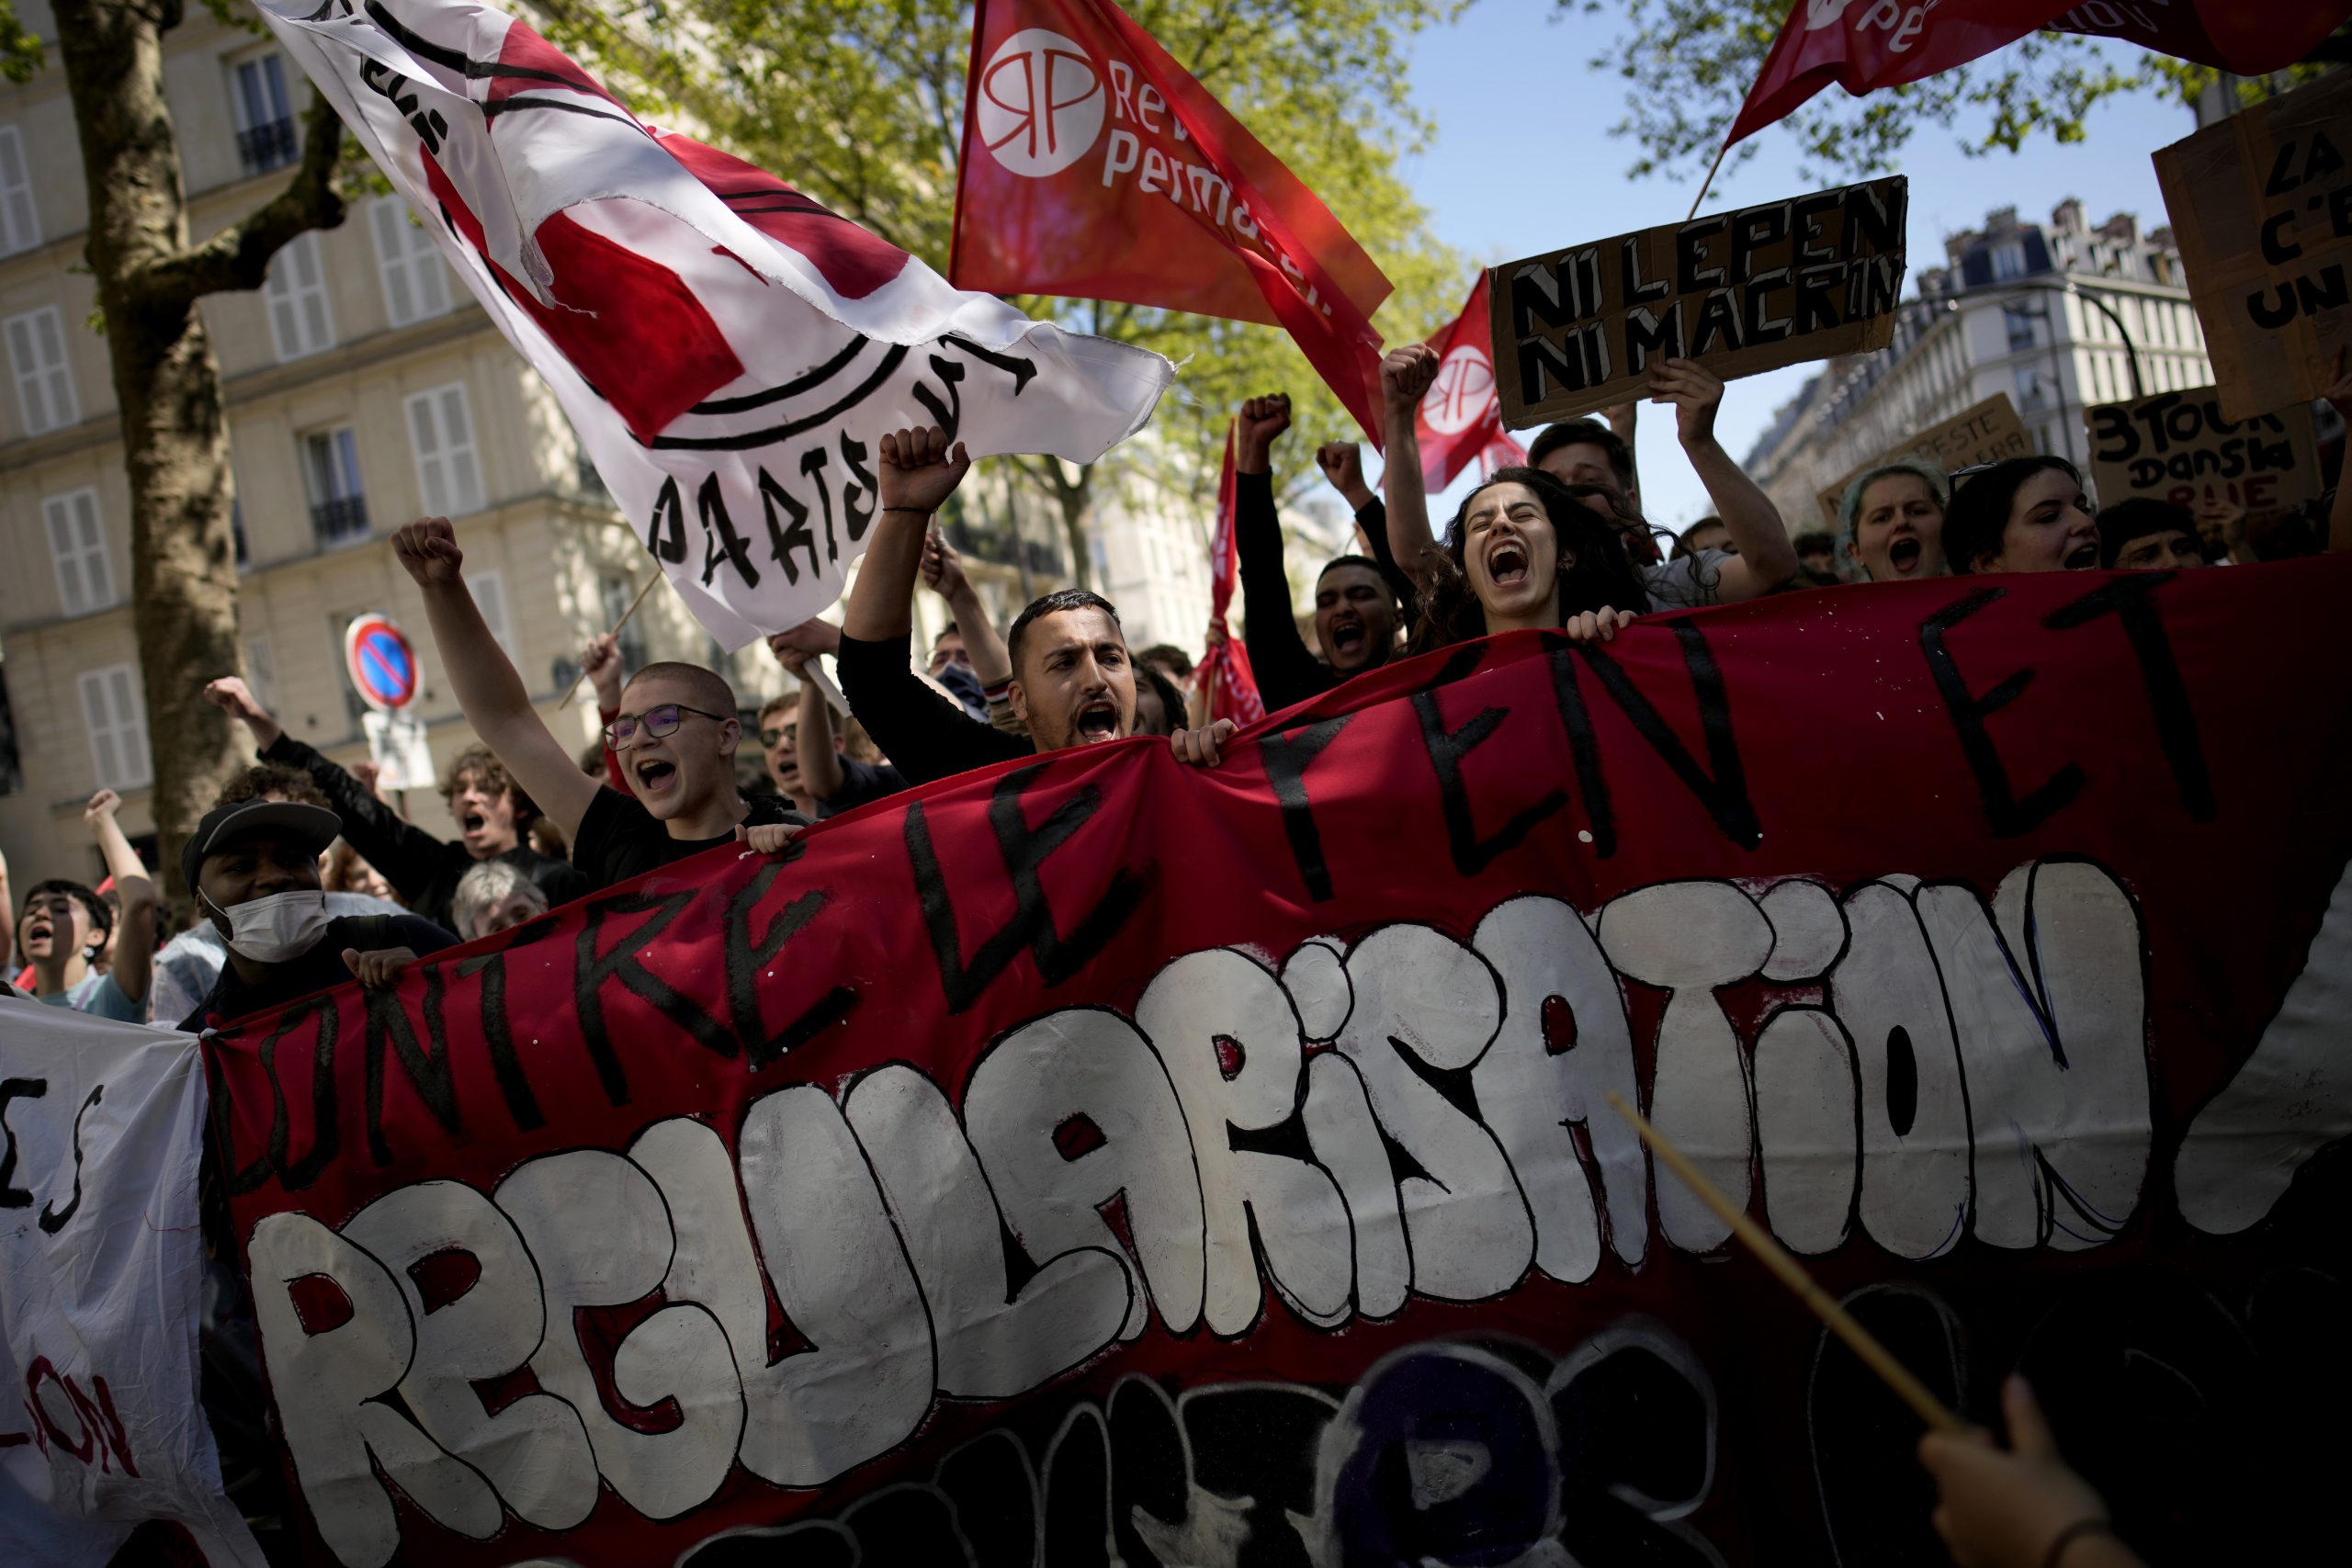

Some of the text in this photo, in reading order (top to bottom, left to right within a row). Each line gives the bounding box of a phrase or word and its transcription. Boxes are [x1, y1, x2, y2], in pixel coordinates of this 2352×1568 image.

[2261, 185, 2352, 265] C'E
[1512, 246, 1604, 339] NI
[1518, 319, 1612, 405] NI
[1920, 571, 2217, 840] ET
